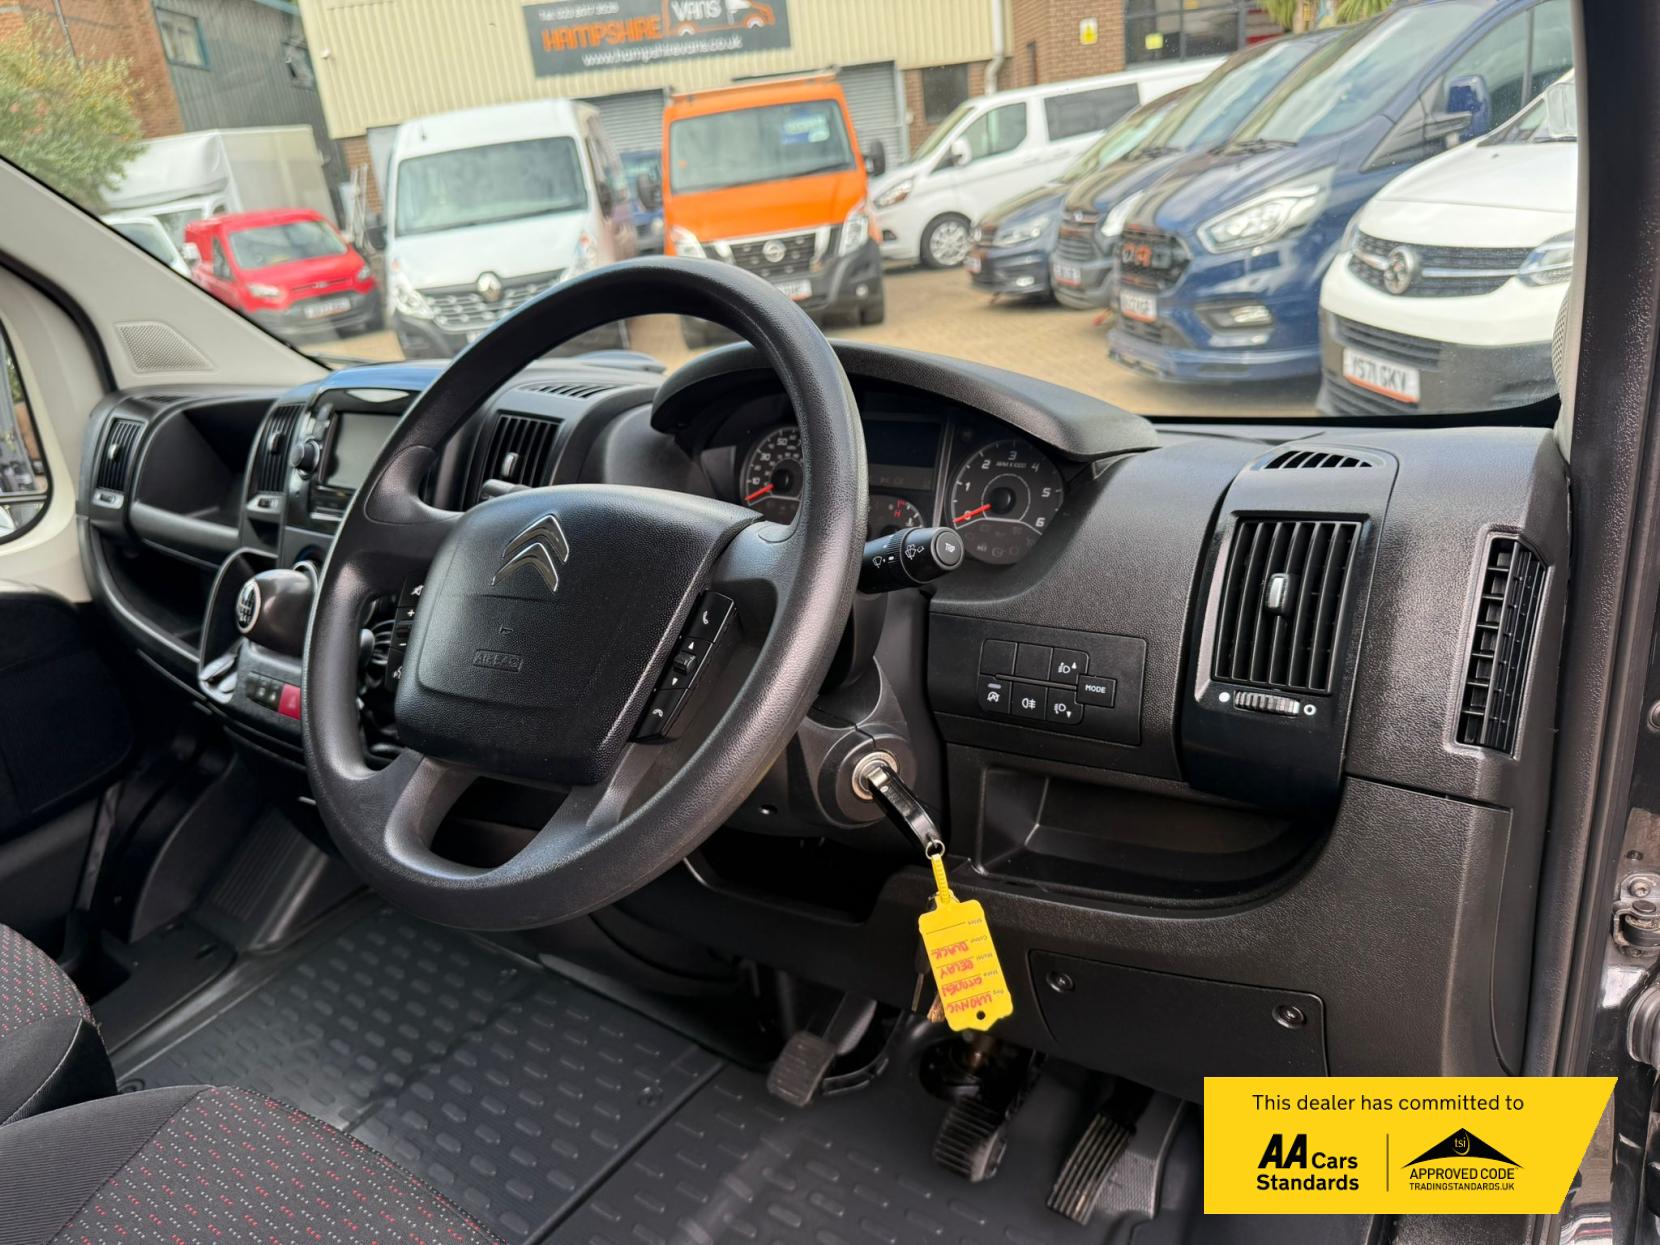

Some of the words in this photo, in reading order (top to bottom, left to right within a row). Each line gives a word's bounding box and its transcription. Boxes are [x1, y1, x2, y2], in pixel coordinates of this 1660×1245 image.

[543, 17, 661, 51] HAMPSHIRE
[671, 0, 722, 22] VANS
[981, 459, 991, 470] 2
[1035, 517, 1045, 528] 6
[1085, 684, 1106, 694] MODE
